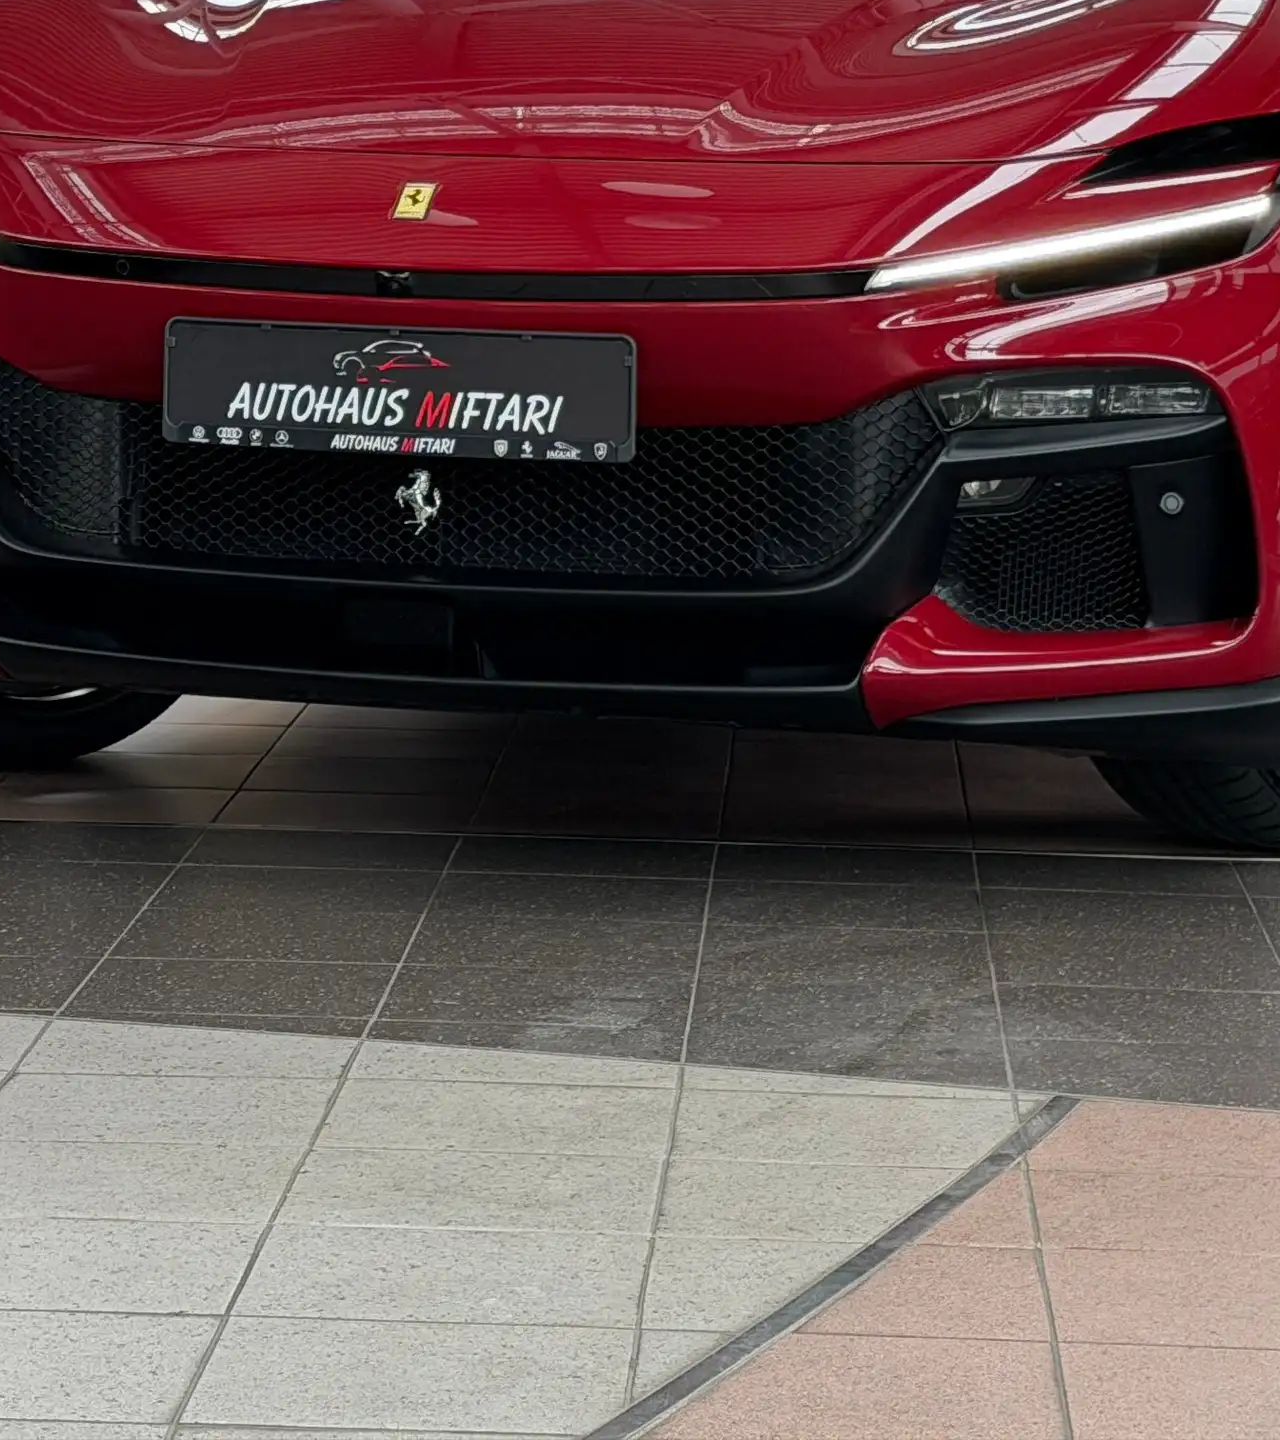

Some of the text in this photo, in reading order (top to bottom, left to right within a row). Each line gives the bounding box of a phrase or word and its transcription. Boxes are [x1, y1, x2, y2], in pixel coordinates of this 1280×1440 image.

[227, 381, 564, 435] AUTOHAUS MIFTARI
[330, 433, 456, 454] AUTOHAUS MIFTARI
